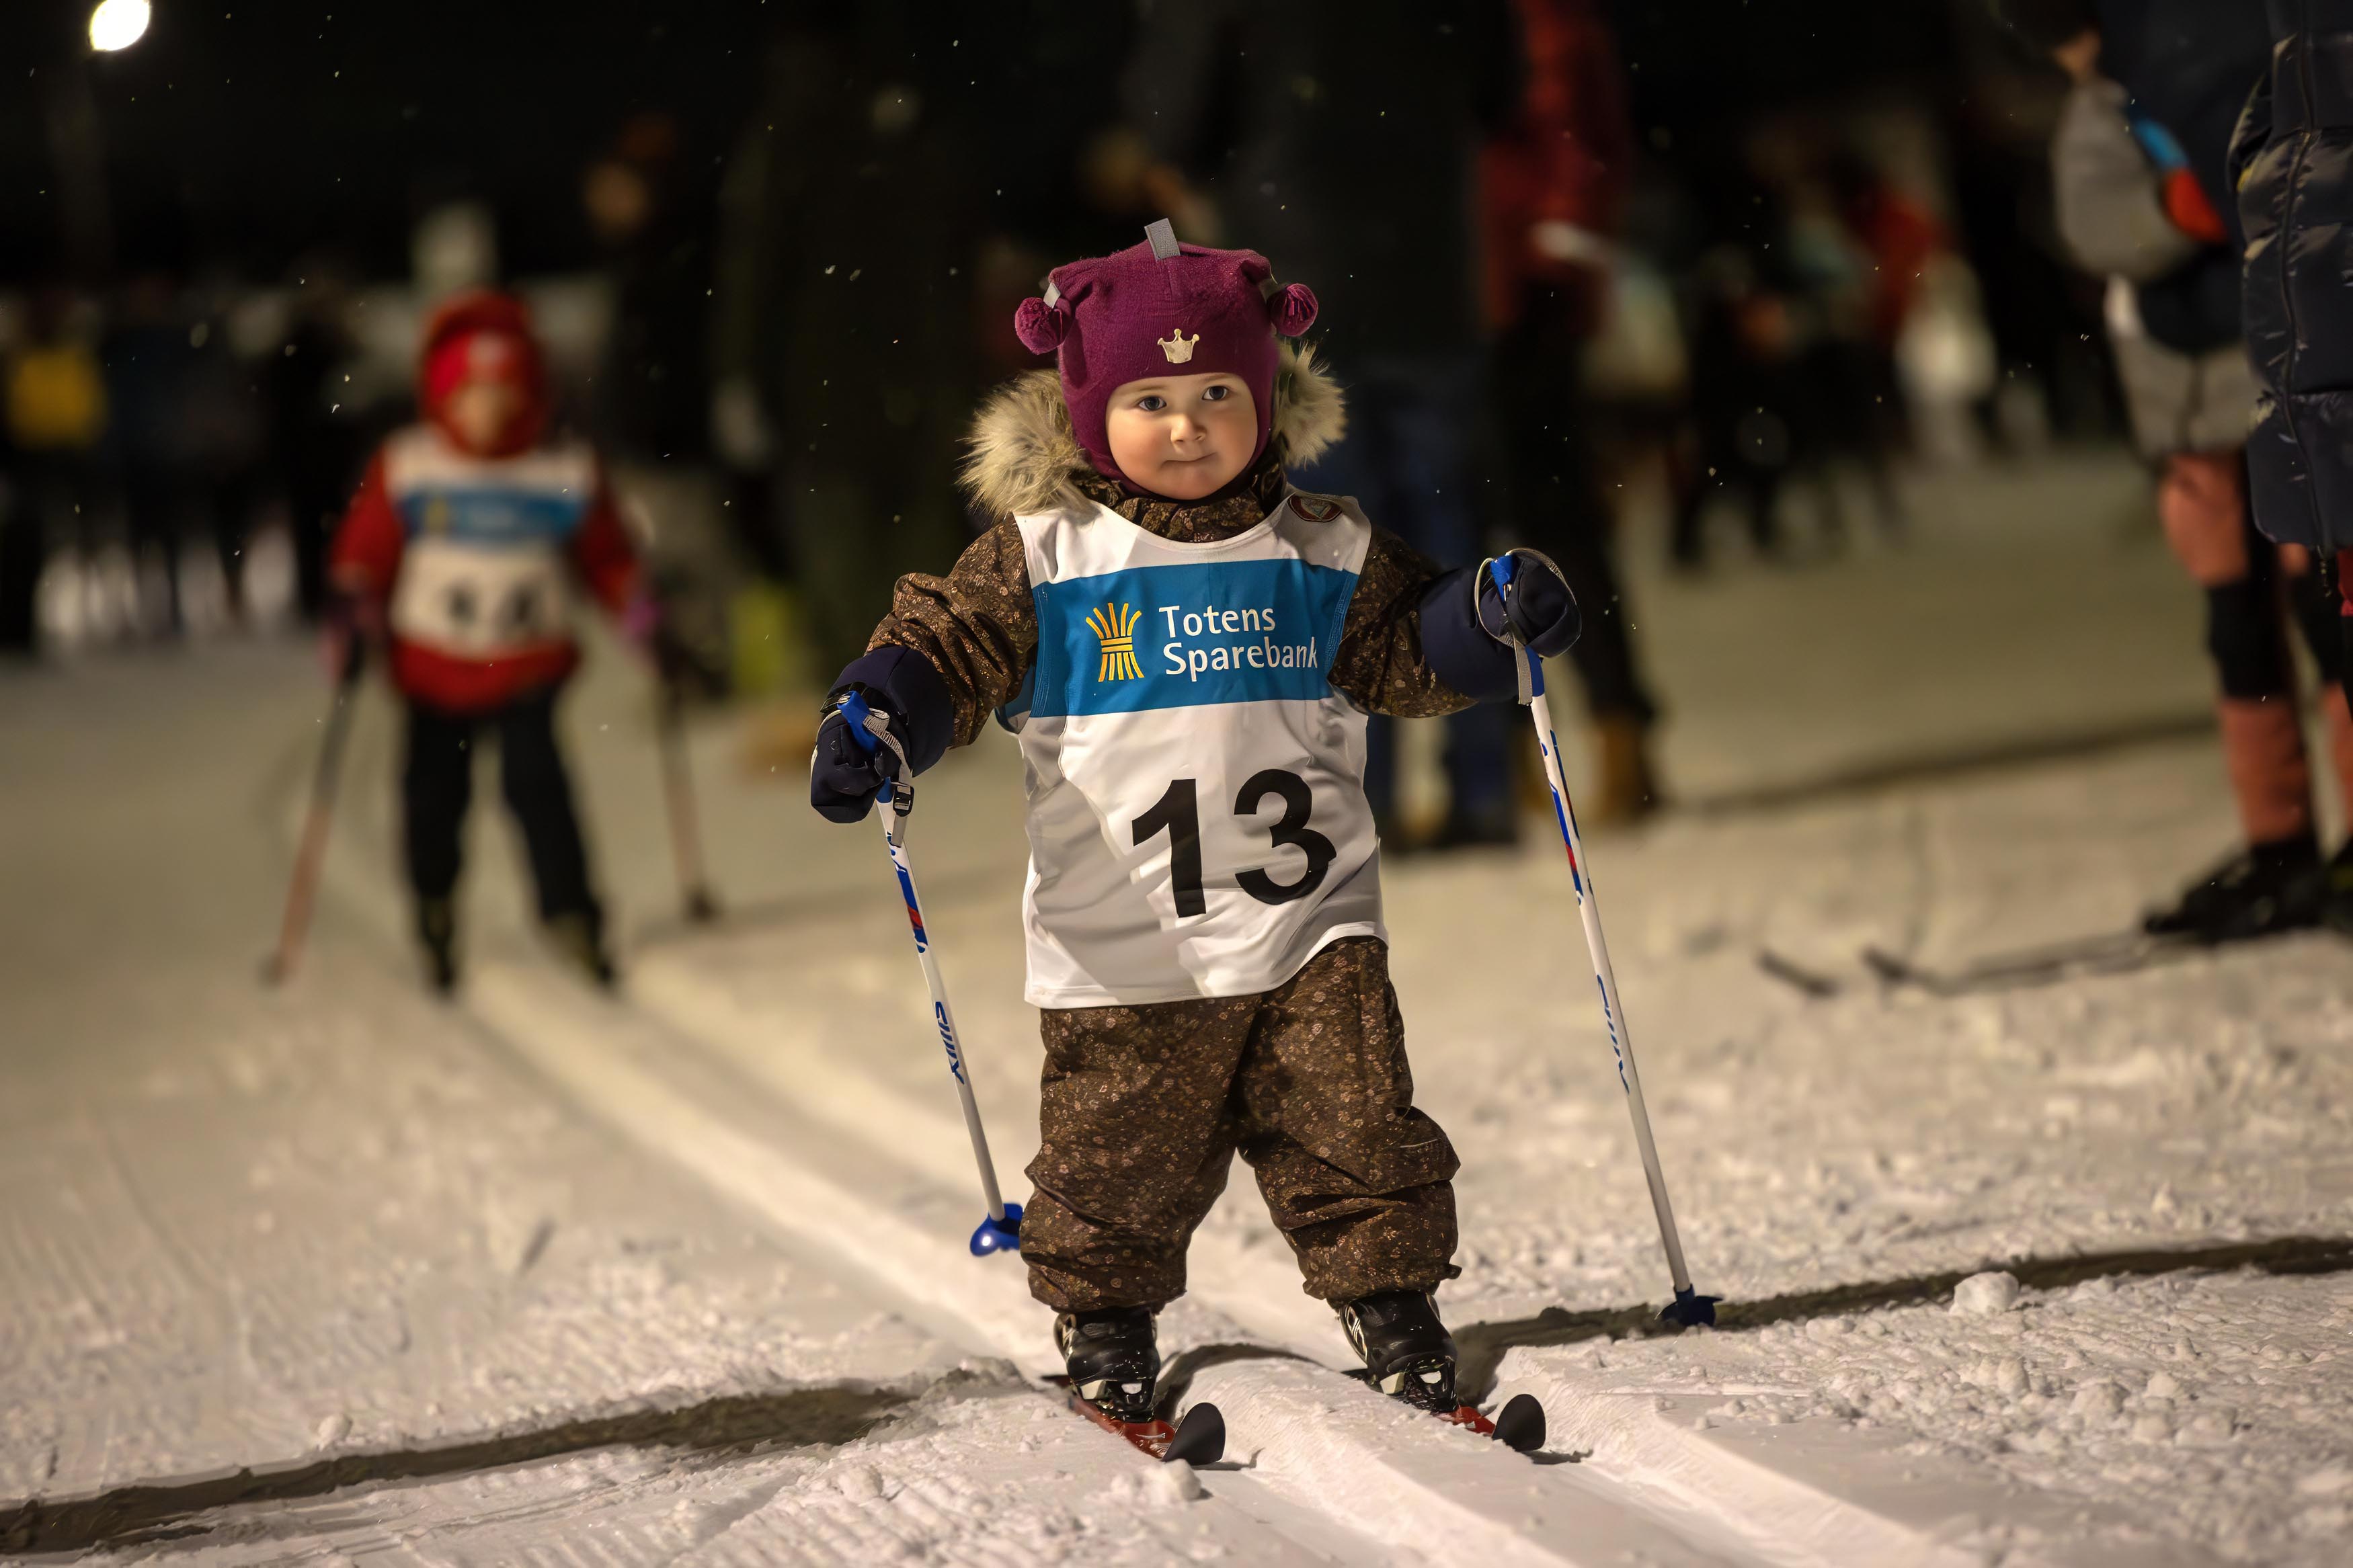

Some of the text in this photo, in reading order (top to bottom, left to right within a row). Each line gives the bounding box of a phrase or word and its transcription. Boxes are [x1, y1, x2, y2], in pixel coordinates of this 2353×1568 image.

[1158, 605, 1276, 638] Totens
[1163, 636, 1318, 682] Sparebank
[1131, 768, 1337, 918] 13
